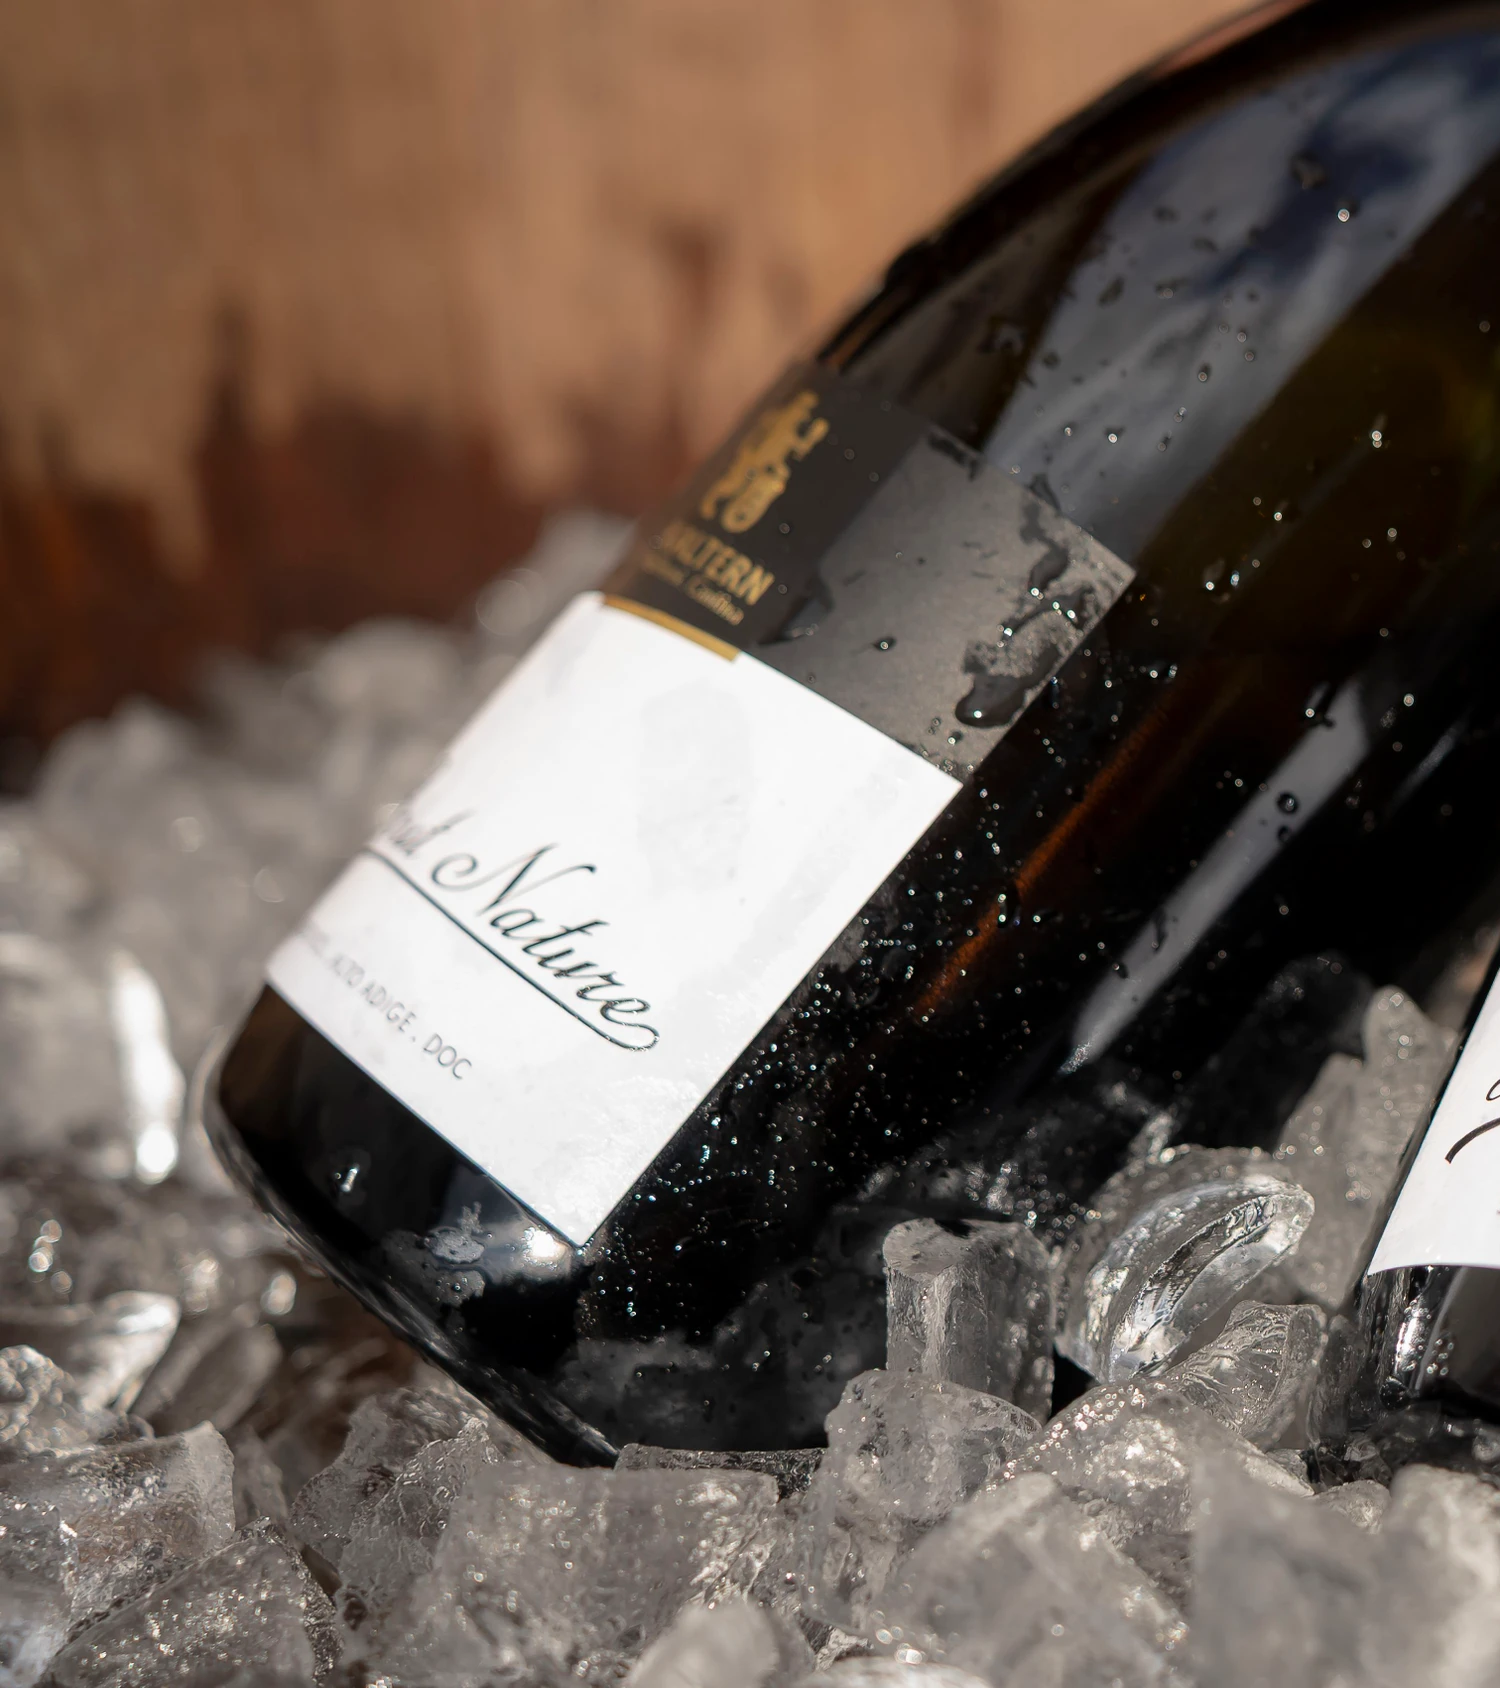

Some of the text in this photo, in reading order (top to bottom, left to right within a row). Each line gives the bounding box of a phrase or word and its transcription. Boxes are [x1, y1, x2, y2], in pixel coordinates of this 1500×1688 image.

[430, 843, 660, 1030] Nature
[360, 980, 417, 1033] ADIGE
[423, 1033, 473, 1080] DOC
